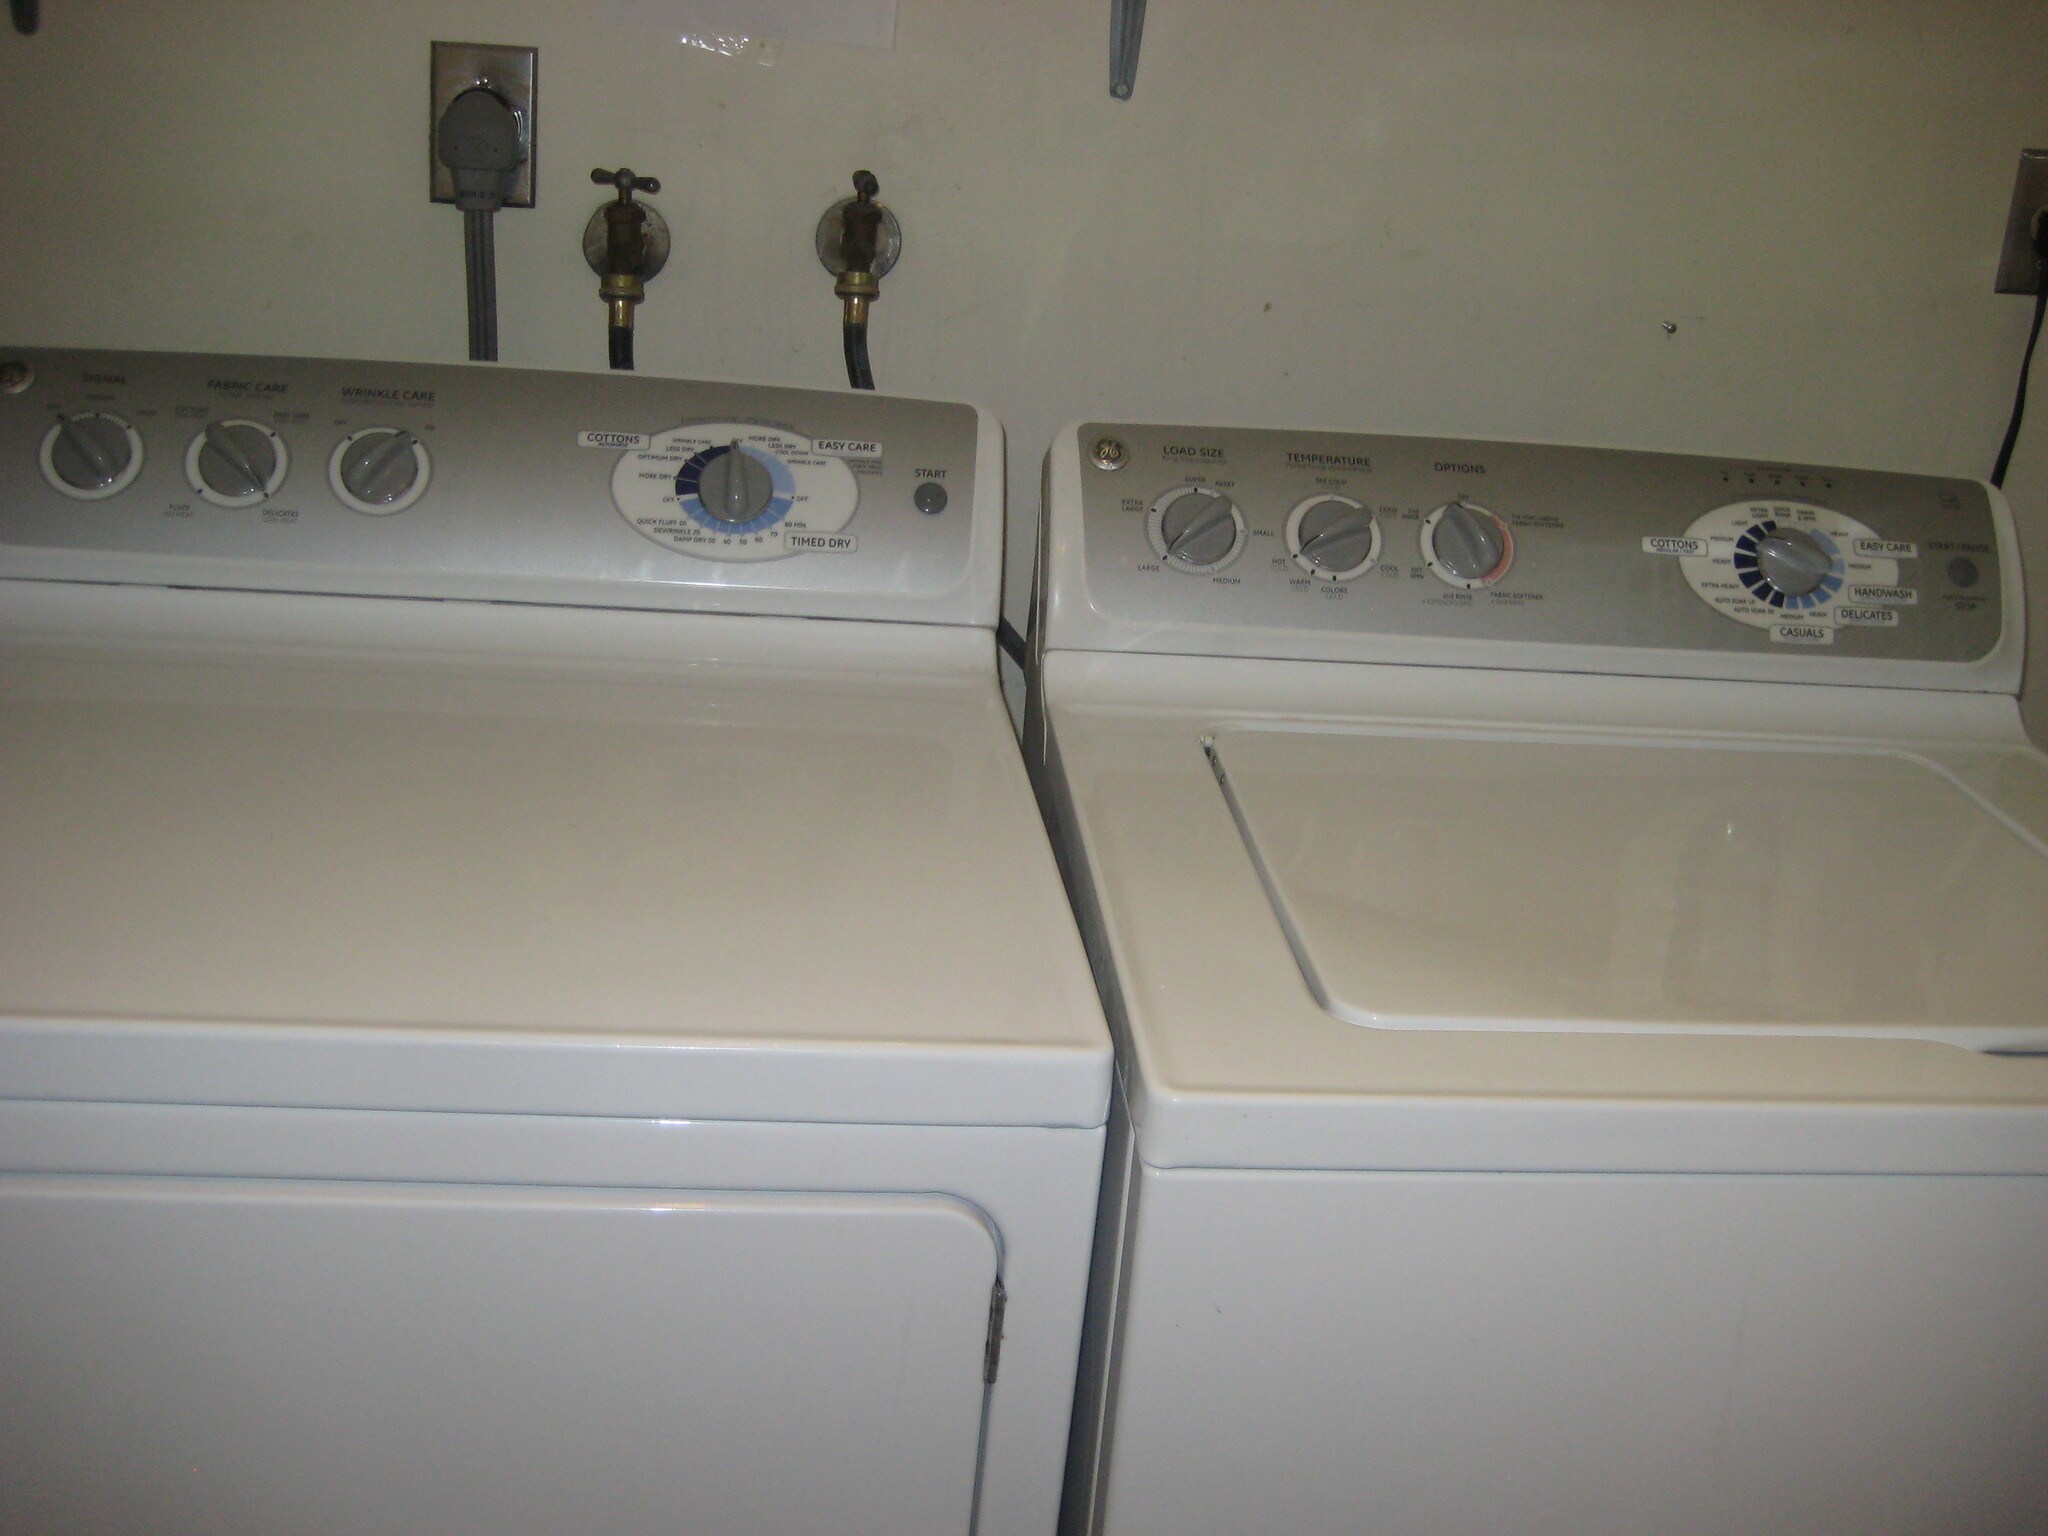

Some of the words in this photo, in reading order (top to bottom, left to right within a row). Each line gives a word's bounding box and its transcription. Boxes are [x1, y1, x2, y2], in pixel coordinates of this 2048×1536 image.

[206, 380, 249, 392] FABRIC
[254, 382, 289, 394] CARE
[341, 386, 400, 400] WRINKLE
[403, 389, 436, 403] CARE
[587, 432, 640, 445] COTTONS
[818, 440, 845, 451] EASY
[847, 442, 877, 453] CARE
[1163, 444, 1197, 457] LOAD
[1199, 447, 1226, 459] SIZE
[637, 453, 669, 461] OPTIMUM
[1286, 452, 1372, 467] TEMPERATURE
[1433, 461, 1489, 475] OPTIONS
[638, 472, 658, 480] MORE
[914, 468, 948, 480] START
[1184, 474, 1206, 483] SUPER
[1214, 479, 1236, 488] RESET
[662, 495, 674, 503] OFF
[262, 509, 300, 518] DELICATES
[1121, 505, 1144, 513] LARGE
[637, 518, 657, 526] QUICK
[793, 522, 807, 530] MIN
[653, 526, 691, 535] DEWRINKLE
[692, 528, 701, 536] 20
[769, 530, 778, 538] 70
[1252, 529, 1275, 537] SMALL
[673, 535, 693, 543] DAMP
[693, 536, 707, 544] DRY
[790, 536, 826, 549] TIMED
[828, 537, 852, 550] DRY
[1650, 537, 1699, 551] COTTONS
[1860, 541, 1884, 552] EASY
[1886, 543, 1913, 553] CARE
[1271, 558, 1287, 566] HOT
[1137, 563, 1161, 572] LARGE
[1380, 564, 1399, 573] COOL
[1212, 576, 1242, 585] MEDIUM
[1288, 577, 1311, 586] WARM
[1701, 581, 1720, 589] EXTRA
[1320, 585, 1348, 594] COLORS
[1854, 586, 1914, 600] HANDWASH
[1455, 593, 1473, 601] RINSE
[1489, 591, 1512, 599] FABRIC
[1512, 593, 1544, 601] SOFTENER
[1714, 596, 1731, 604] AUTO
[1731, 597, 1747, 605] SOAK
[1841, 608, 1894, 621] DELICATES
[1778, 626, 1825, 640] CASUALS
